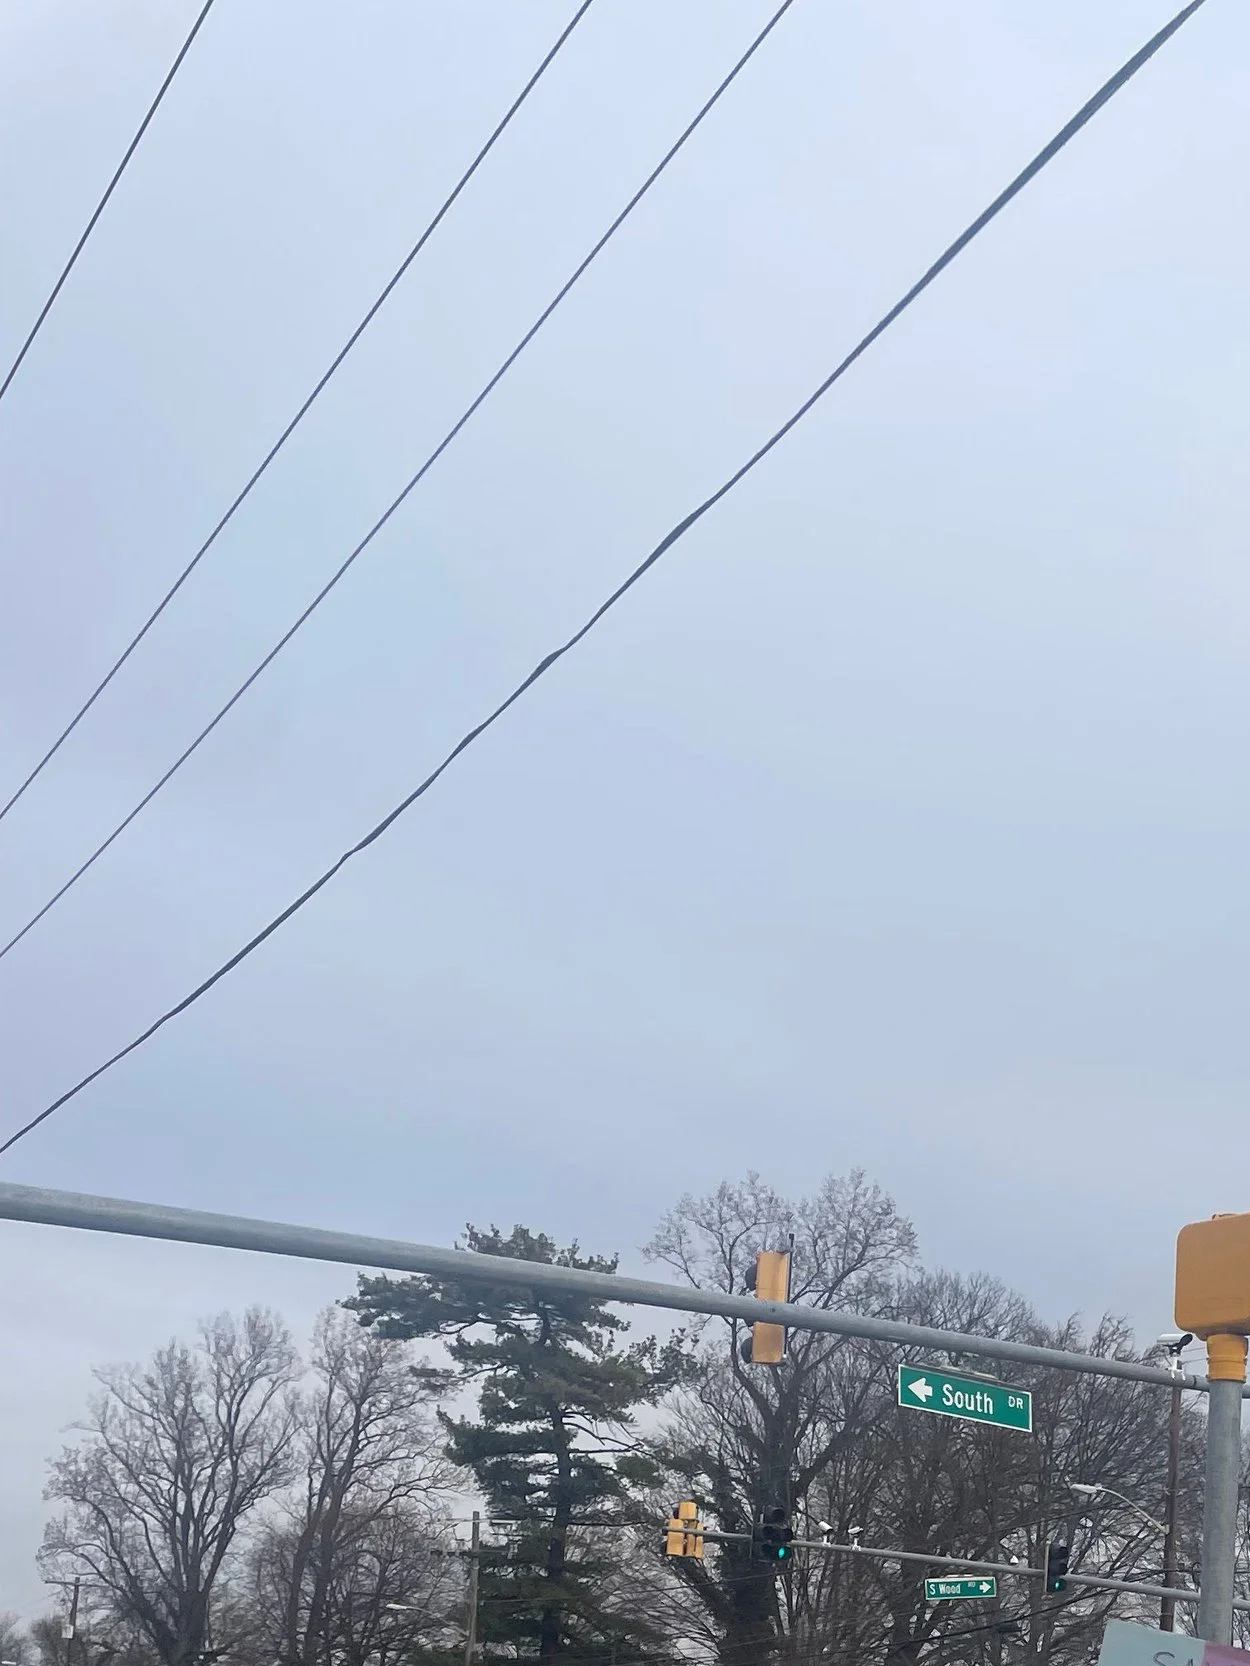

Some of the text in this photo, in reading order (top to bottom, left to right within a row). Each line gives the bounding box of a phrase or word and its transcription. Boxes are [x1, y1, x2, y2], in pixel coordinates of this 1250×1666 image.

[942, 1384, 1024, 1415] South DR
[929, 1583, 936, 1595] S
[938, 1583, 961, 1595] Wood
